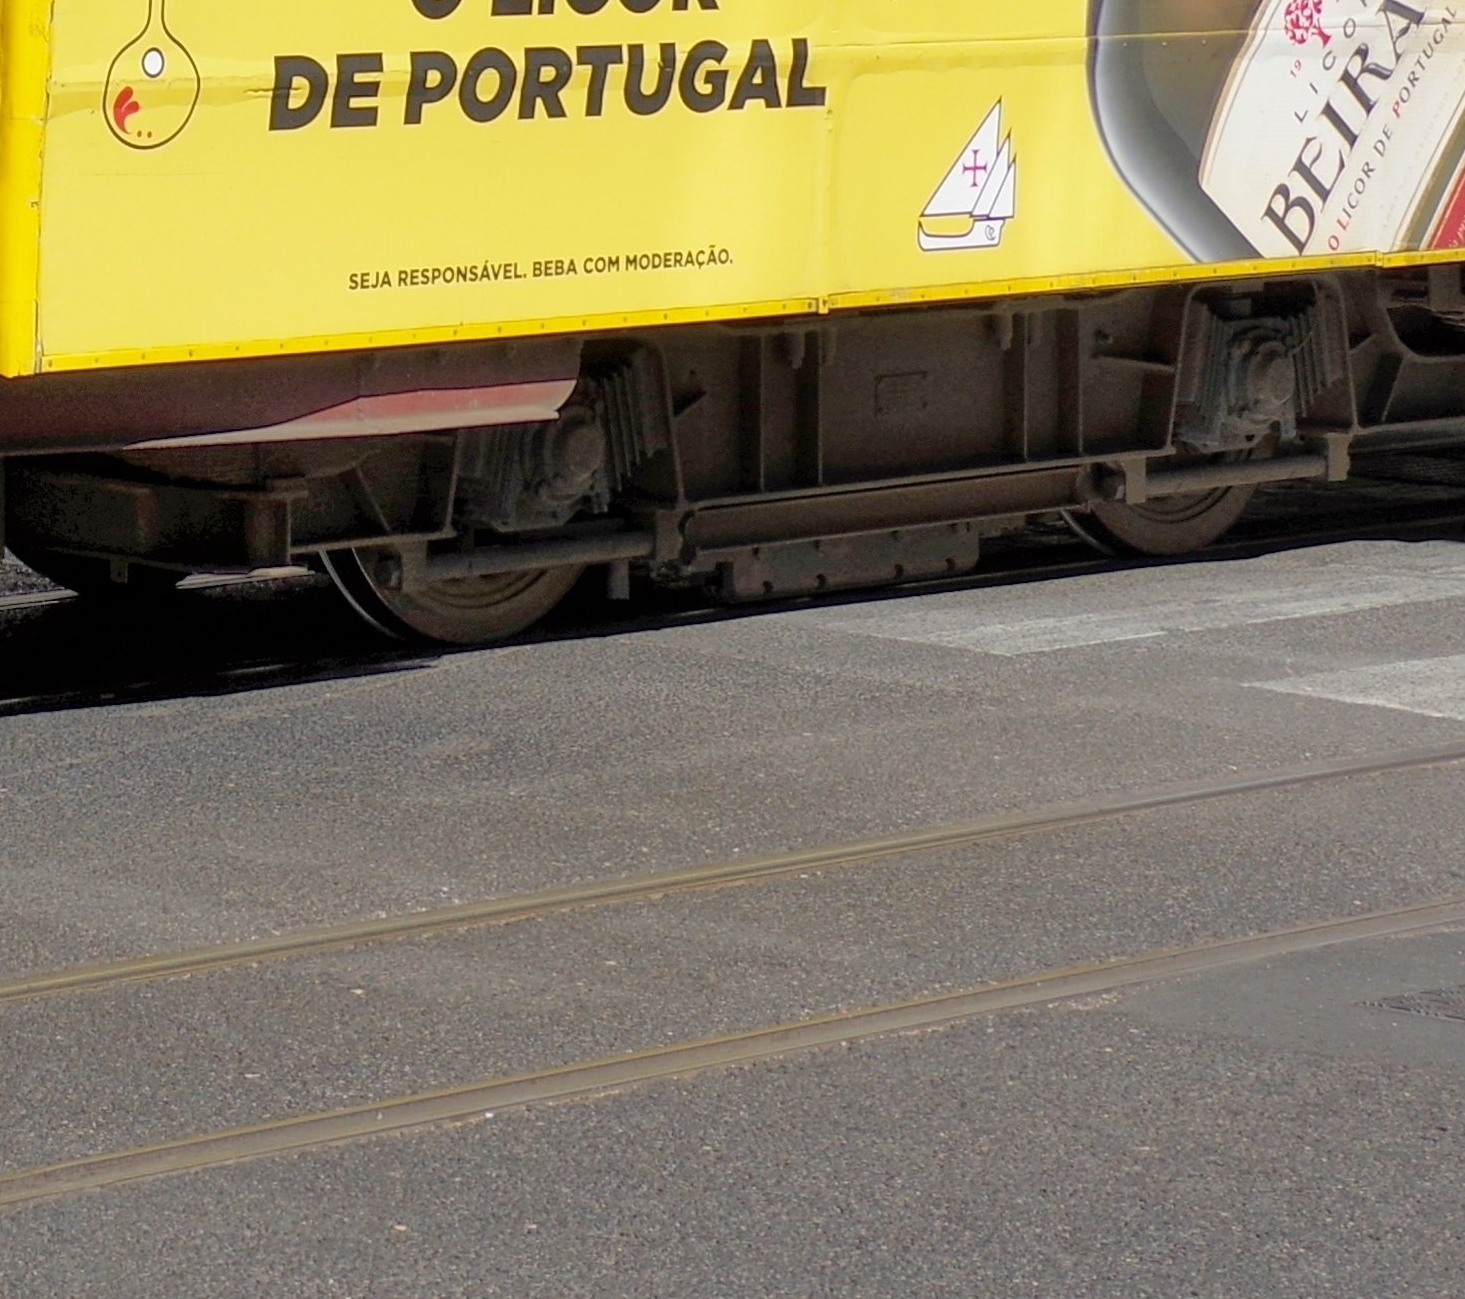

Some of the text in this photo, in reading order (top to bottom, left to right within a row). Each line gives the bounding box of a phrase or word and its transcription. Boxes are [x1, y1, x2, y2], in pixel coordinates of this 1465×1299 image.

[268, 37, 828, 132] DE PORTUGAL
[1327, 5, 1460, 252] O LICOR DE PORTUGAL
[348, 243, 733, 291] SEJA RESPONSÁVEL. BEBA COM MODERAÇÃO.
